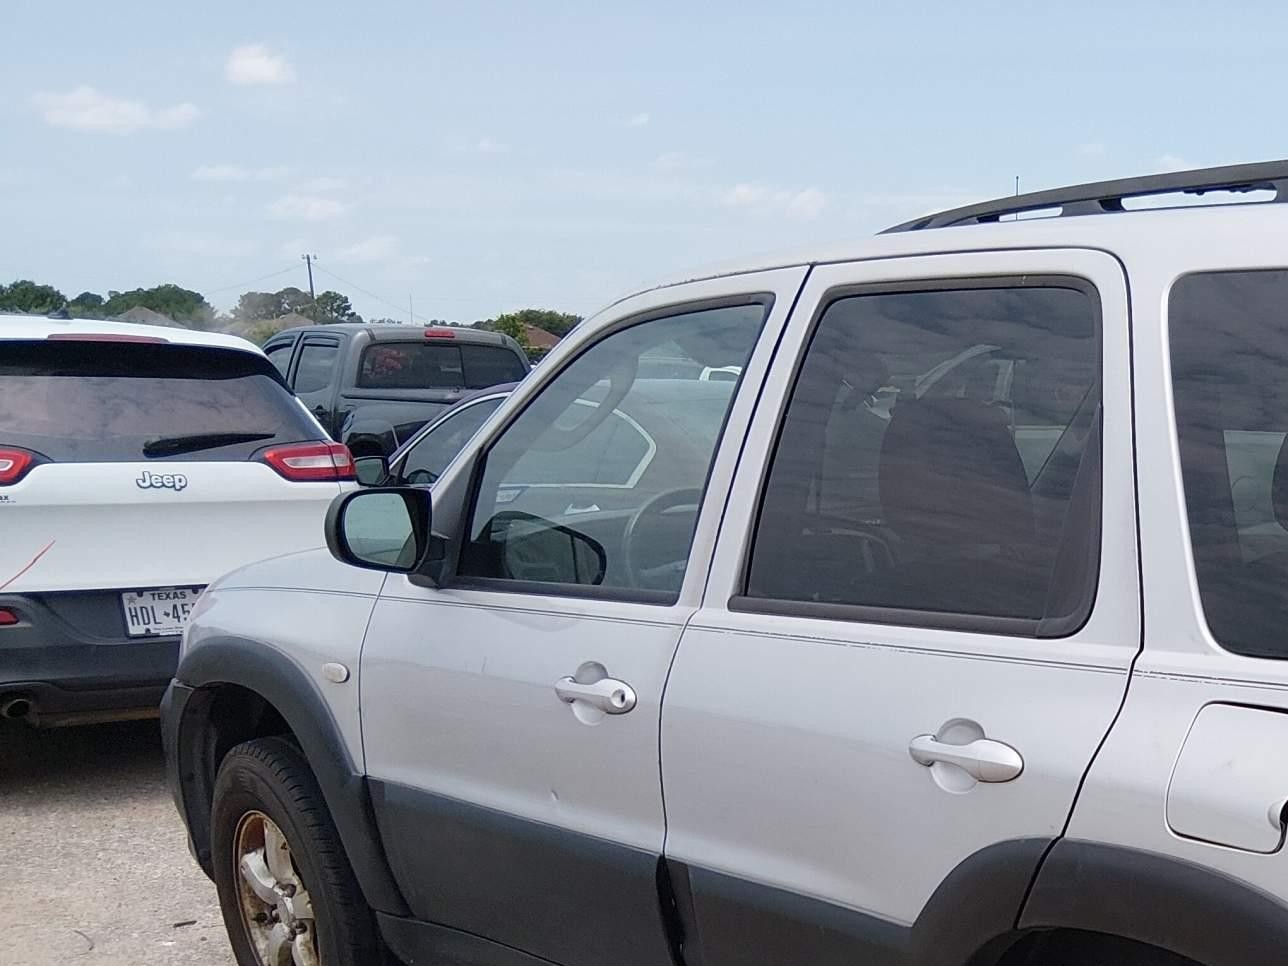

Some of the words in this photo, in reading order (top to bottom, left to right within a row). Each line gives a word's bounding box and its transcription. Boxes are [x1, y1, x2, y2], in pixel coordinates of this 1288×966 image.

[136, 471, 187, 491] Jeep
[150, 591, 187, 601] TEXAS
[128, 605, 163, 626] HDL
[172, 602, 196, 622] 45
